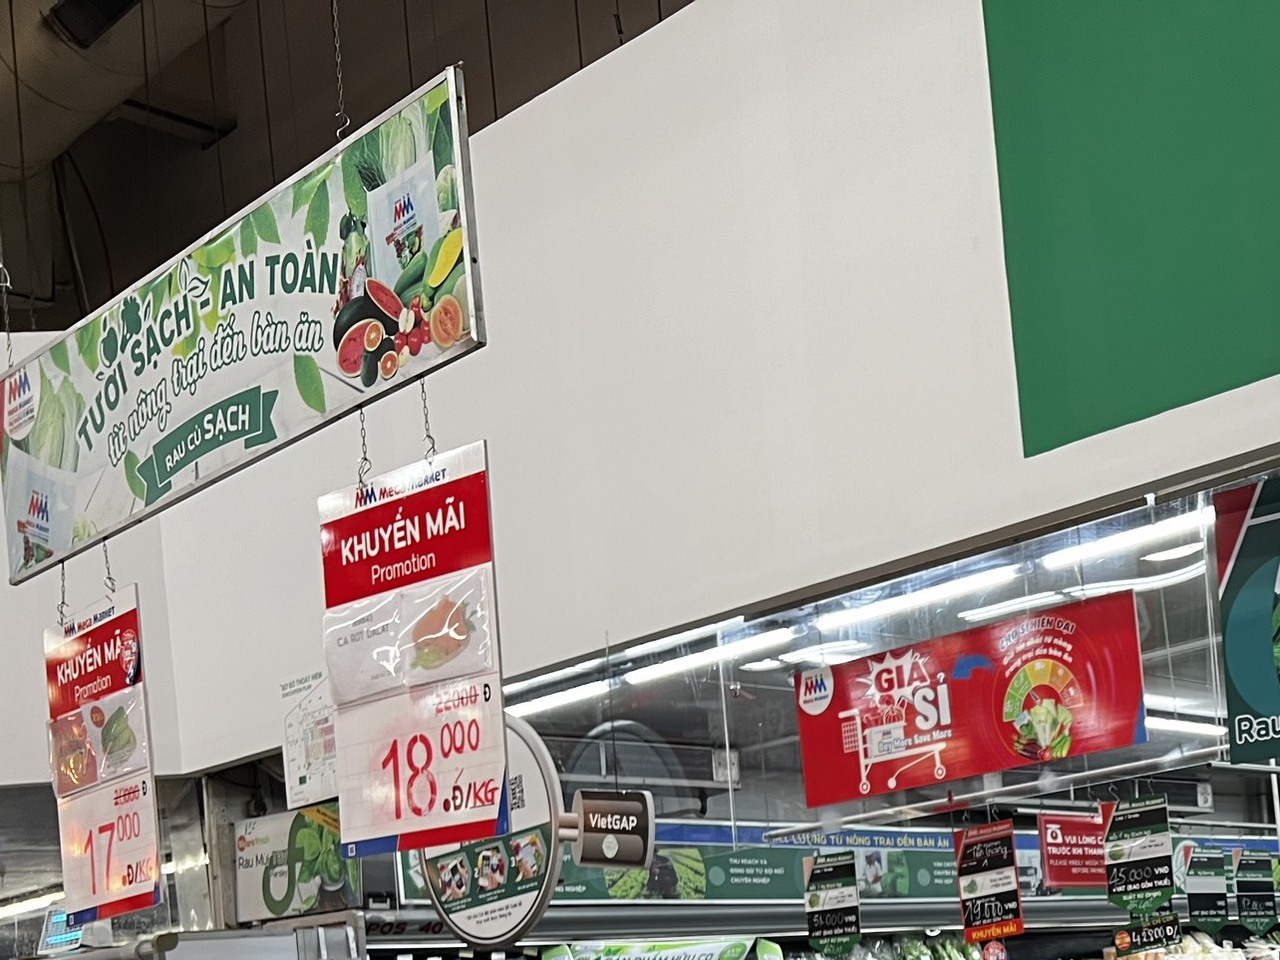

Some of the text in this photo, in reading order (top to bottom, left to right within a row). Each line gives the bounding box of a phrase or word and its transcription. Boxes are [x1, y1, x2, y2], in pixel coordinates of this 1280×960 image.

[130, 293, 192, 377] SẠCH
[220, 259, 255, 311] AN
[265, 239, 339, 296] TOÀN
[127, 378, 172, 433] nông
[171, 336, 208, 397] trại
[209, 312, 248, 372] đến
[250, 309, 290, 357] bàn
[293, 311, 324, 353] ăn
[164, 403, 250, 472] RAU CỦ SẠCH
[340, 496, 466, 566] KHUYẾN MÃI
[371, 551, 437, 585] Promotion
[56, 637, 103, 687] KHUYẾN
[74, 673, 112, 703] Promotion
[381, 718, 480, 820] 18 000
[84, 811, 141, 896] 17 000
[589, 812, 638, 832] VietGAP
[417, 921, 445, 936] 40
